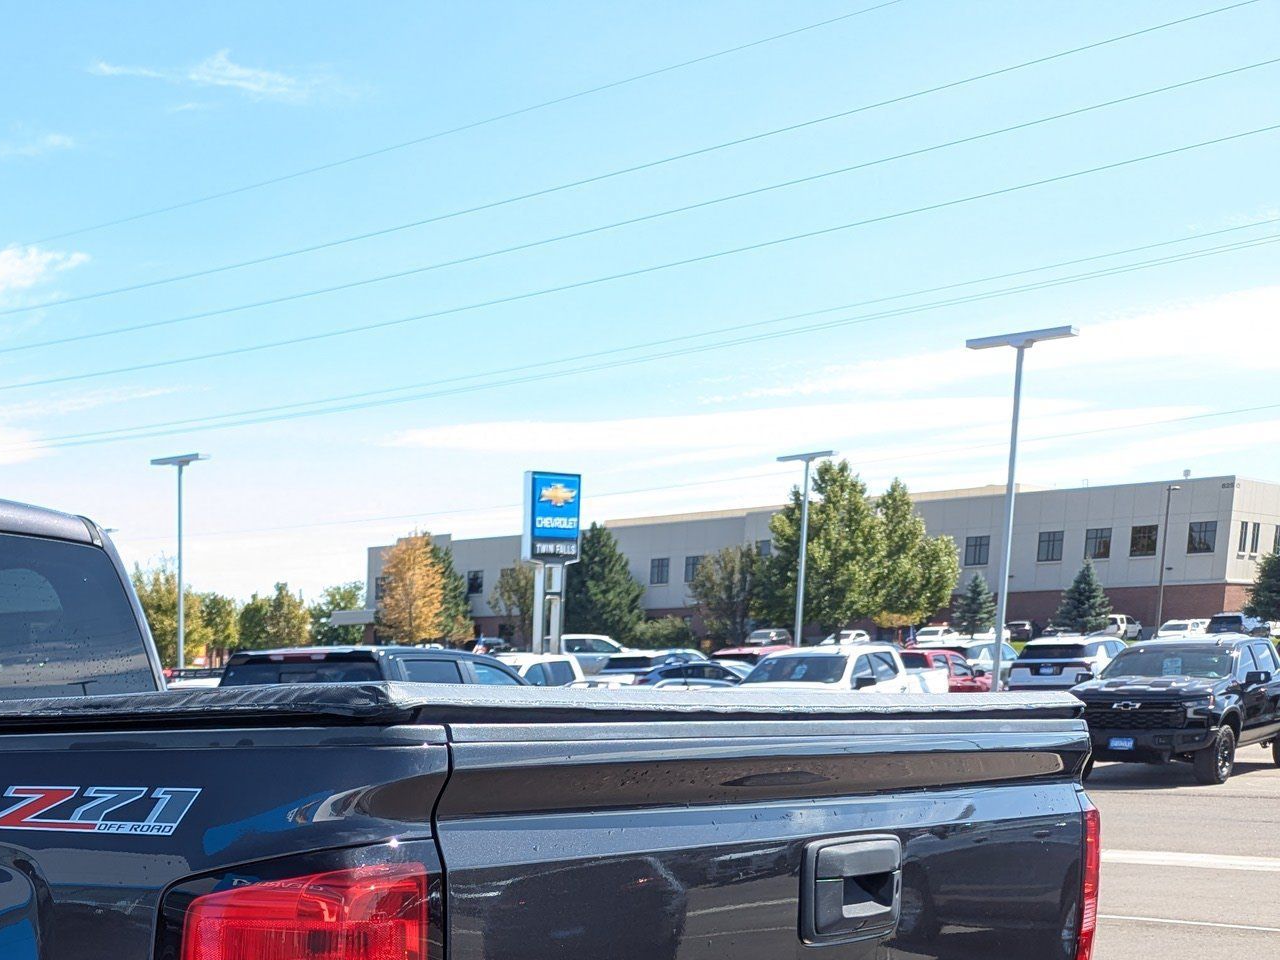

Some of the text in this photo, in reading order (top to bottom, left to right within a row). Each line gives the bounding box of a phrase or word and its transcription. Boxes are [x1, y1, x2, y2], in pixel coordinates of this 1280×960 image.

[536, 516, 578, 528] CHEVROLET
[536, 543, 576, 554] TWIN FALLS
[97, 823, 174, 834] OFF ROAD
